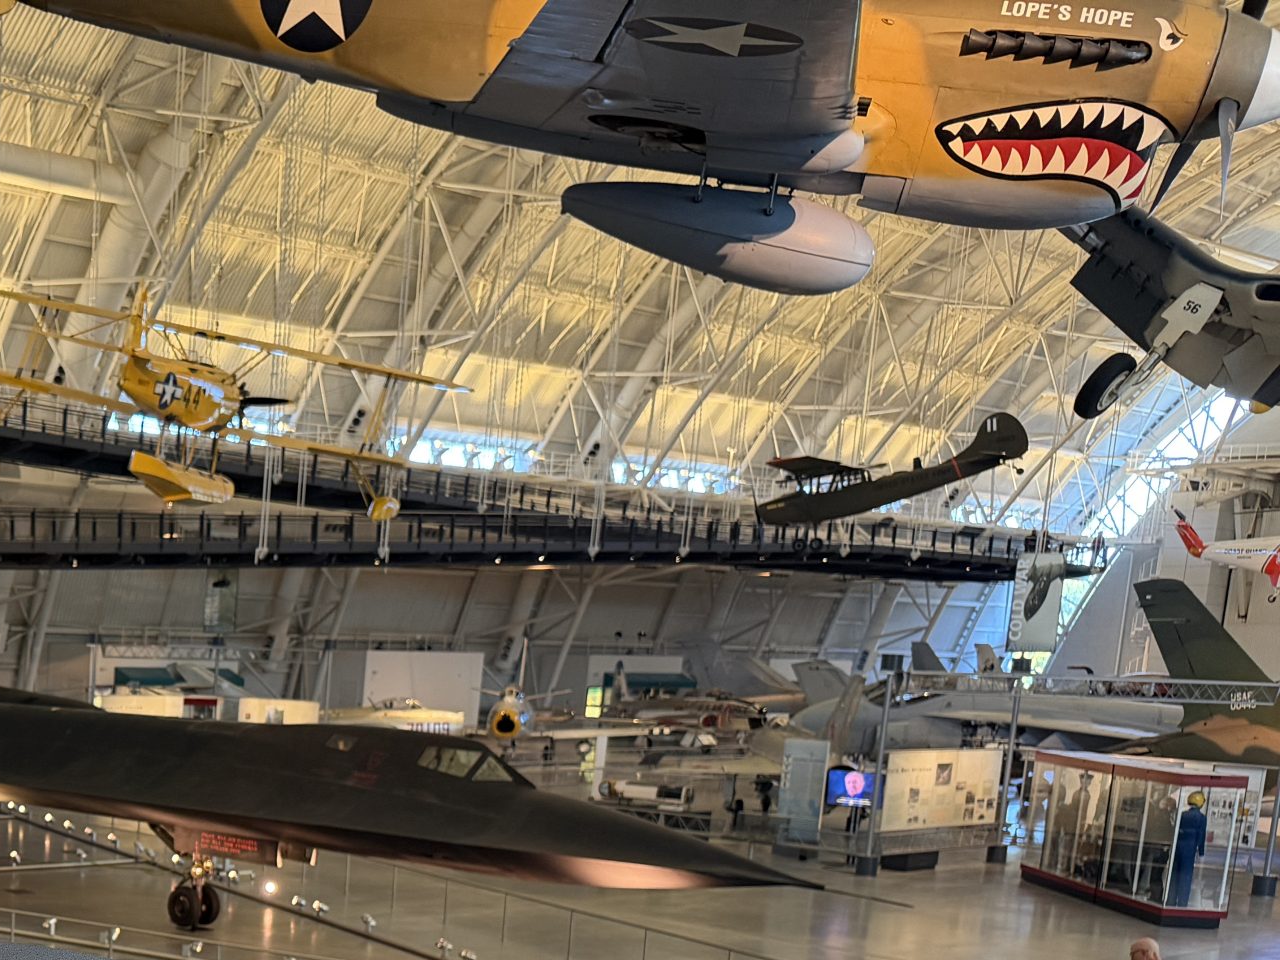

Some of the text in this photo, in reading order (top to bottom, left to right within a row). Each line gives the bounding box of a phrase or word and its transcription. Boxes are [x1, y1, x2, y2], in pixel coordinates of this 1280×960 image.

[1001, 0, 1135, 28] LOPE'S HOPE
[1183, 299, 1201, 314] 56
[1009, 601, 1024, 640] COLD
[1230, 691, 1253, 701] USAF
